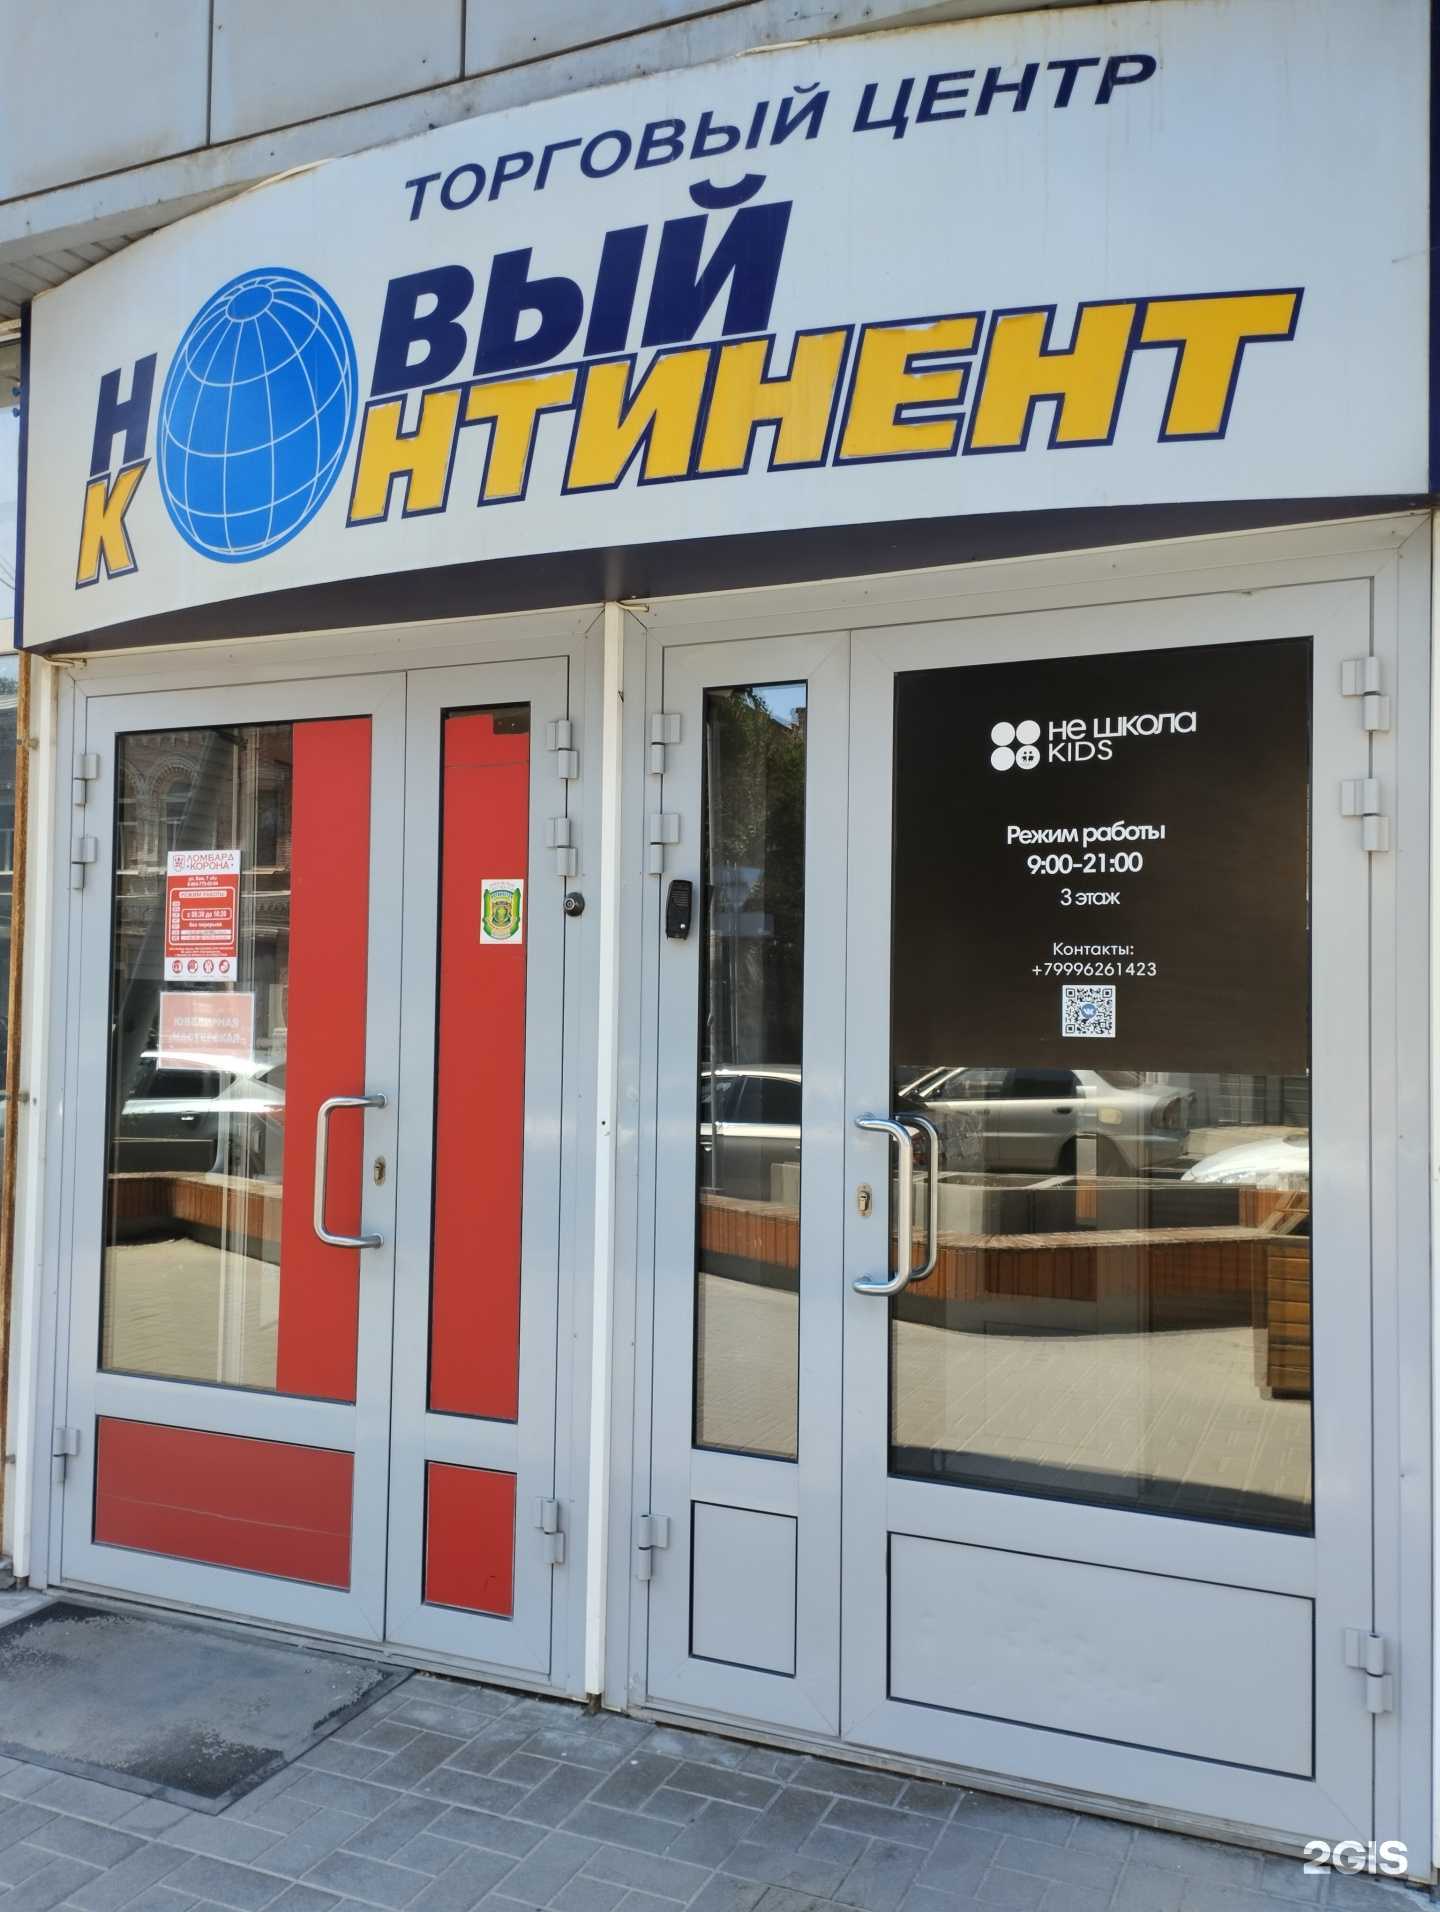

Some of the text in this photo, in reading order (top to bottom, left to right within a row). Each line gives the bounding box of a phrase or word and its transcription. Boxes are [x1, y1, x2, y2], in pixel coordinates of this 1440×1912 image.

[404, 54, 1158, 221] ТОРГОВЫЙ ЦЕНТР
[1048, 739, 1113, 763] KIDS
[1007, 820, 1166, 848] Режим работы
[186, 853, 234, 862] ЛОМБАРД
[1027, 851, 1143, 875] 9:00-21:00
[1060, 888, 1120, 906] 3 этаж
[1053, 942, 1135, 956] Контакты:
[1032, 962, 1157, 977] +79996261423
